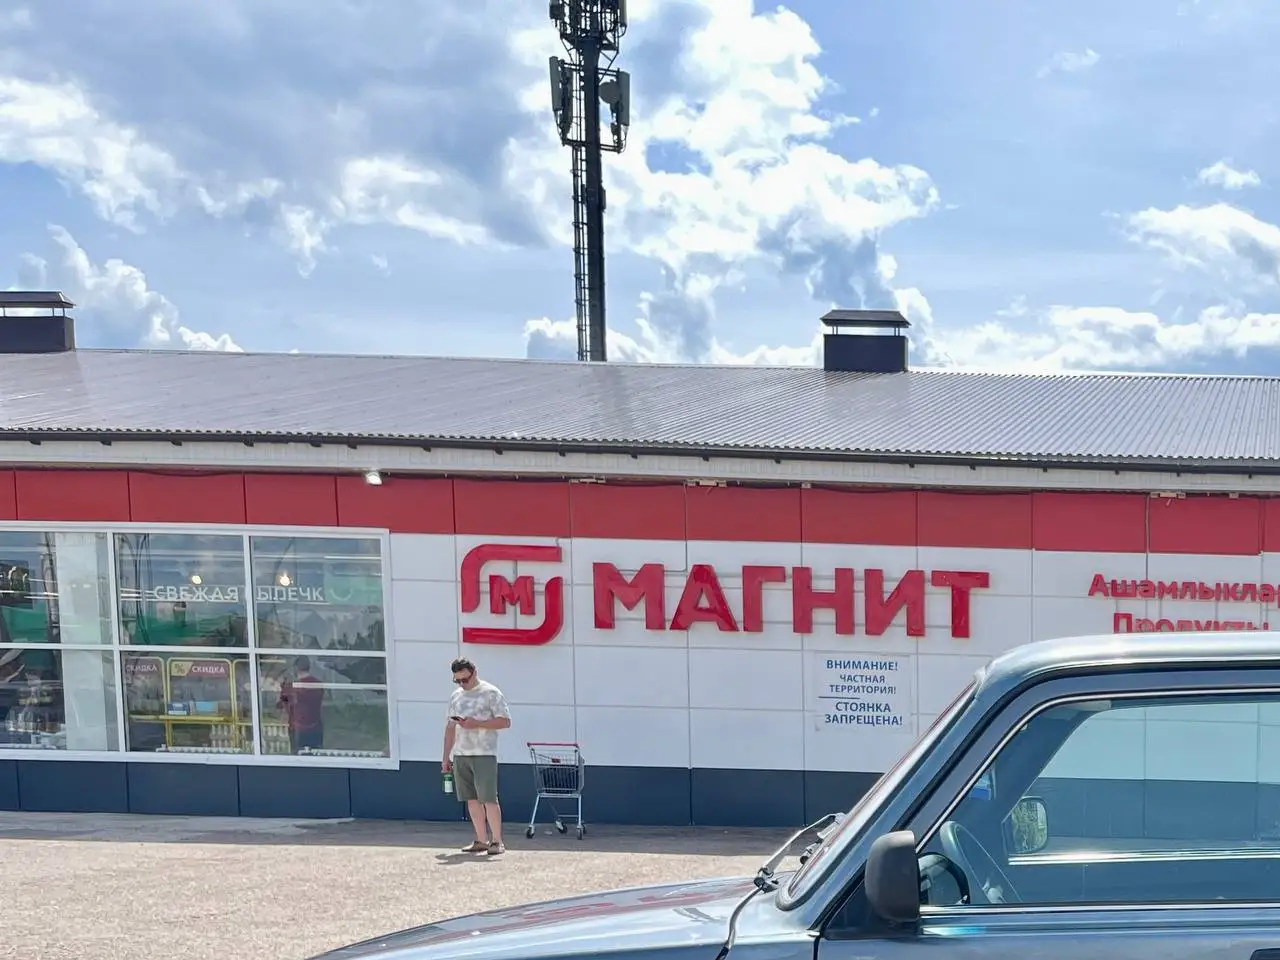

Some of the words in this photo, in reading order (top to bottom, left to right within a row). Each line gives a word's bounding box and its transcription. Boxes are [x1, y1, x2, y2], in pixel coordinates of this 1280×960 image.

[154, 585, 239, 601] СВЕЖАЯ
[256, 587, 325, 601] ЫПЕЧК
[592, 561, 990, 639] МАГНИТ
[191, 665, 226, 674] СКИДКА
[826, 659, 898, 671] ВНИМАНИЕ!
[839, 674, 885, 683] ЧАСТНАЯ
[829, 684, 897, 694] ТЕРРИТОРИЯ!
[835, 701, 891, 713] СТОЯНКА
[824, 713, 903, 727] ЗАПРЕЩЕНА!
